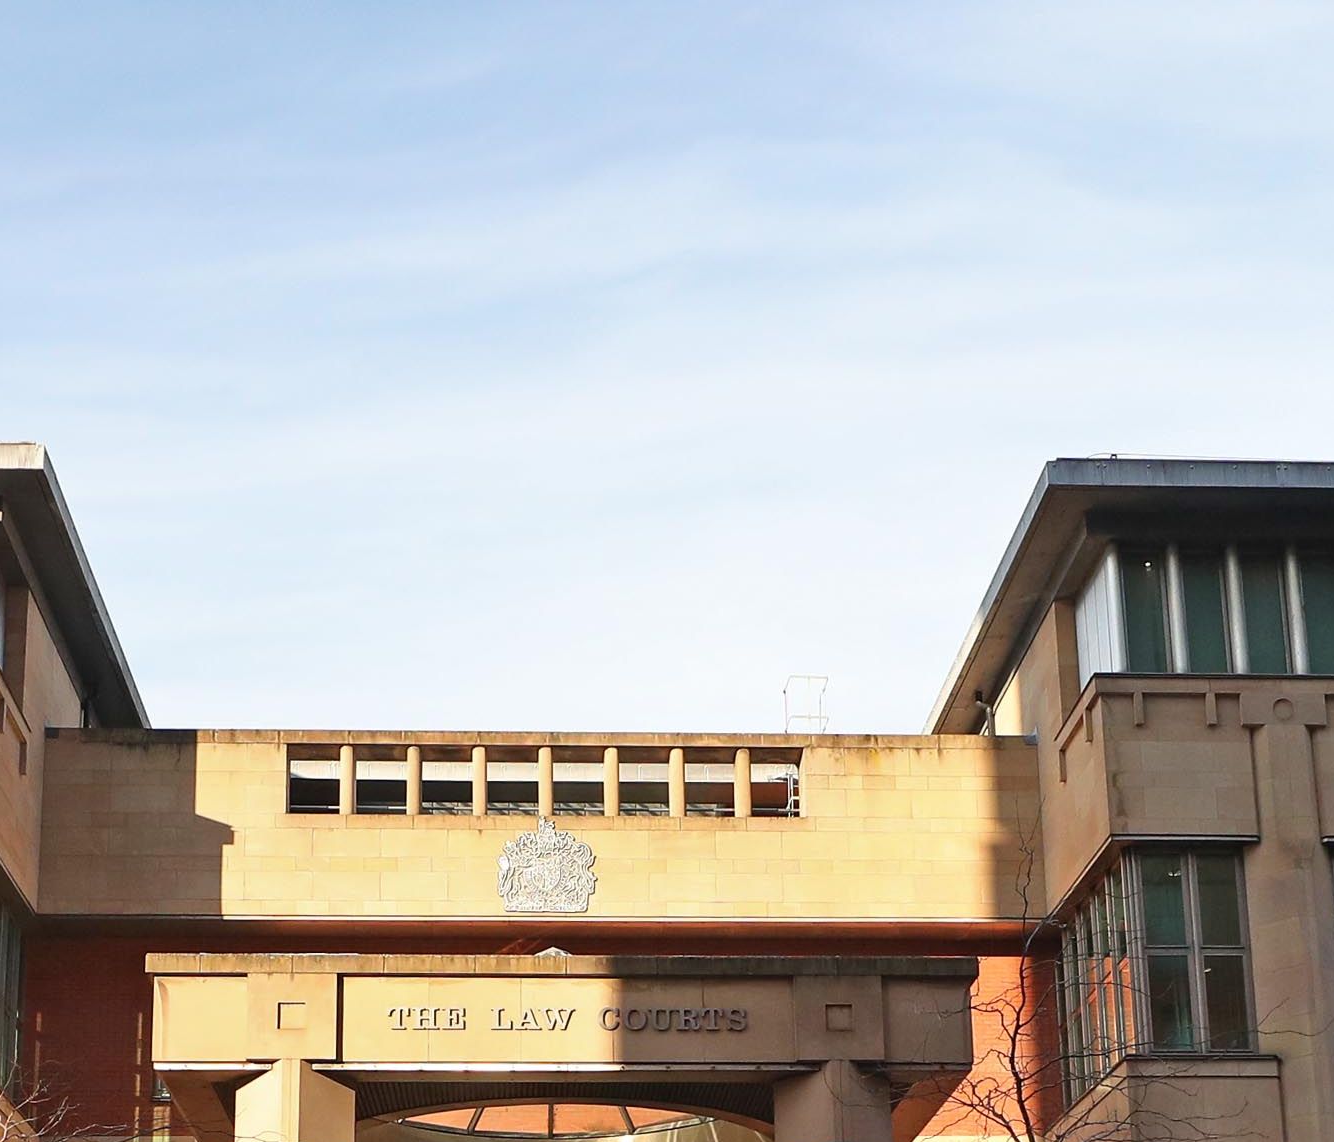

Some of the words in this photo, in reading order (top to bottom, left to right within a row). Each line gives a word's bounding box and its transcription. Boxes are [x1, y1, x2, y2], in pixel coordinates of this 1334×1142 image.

[388, 1007, 467, 1031] THE
[490, 1007, 576, 1031] LAW
[599, 1006, 748, 1032] COURTS
